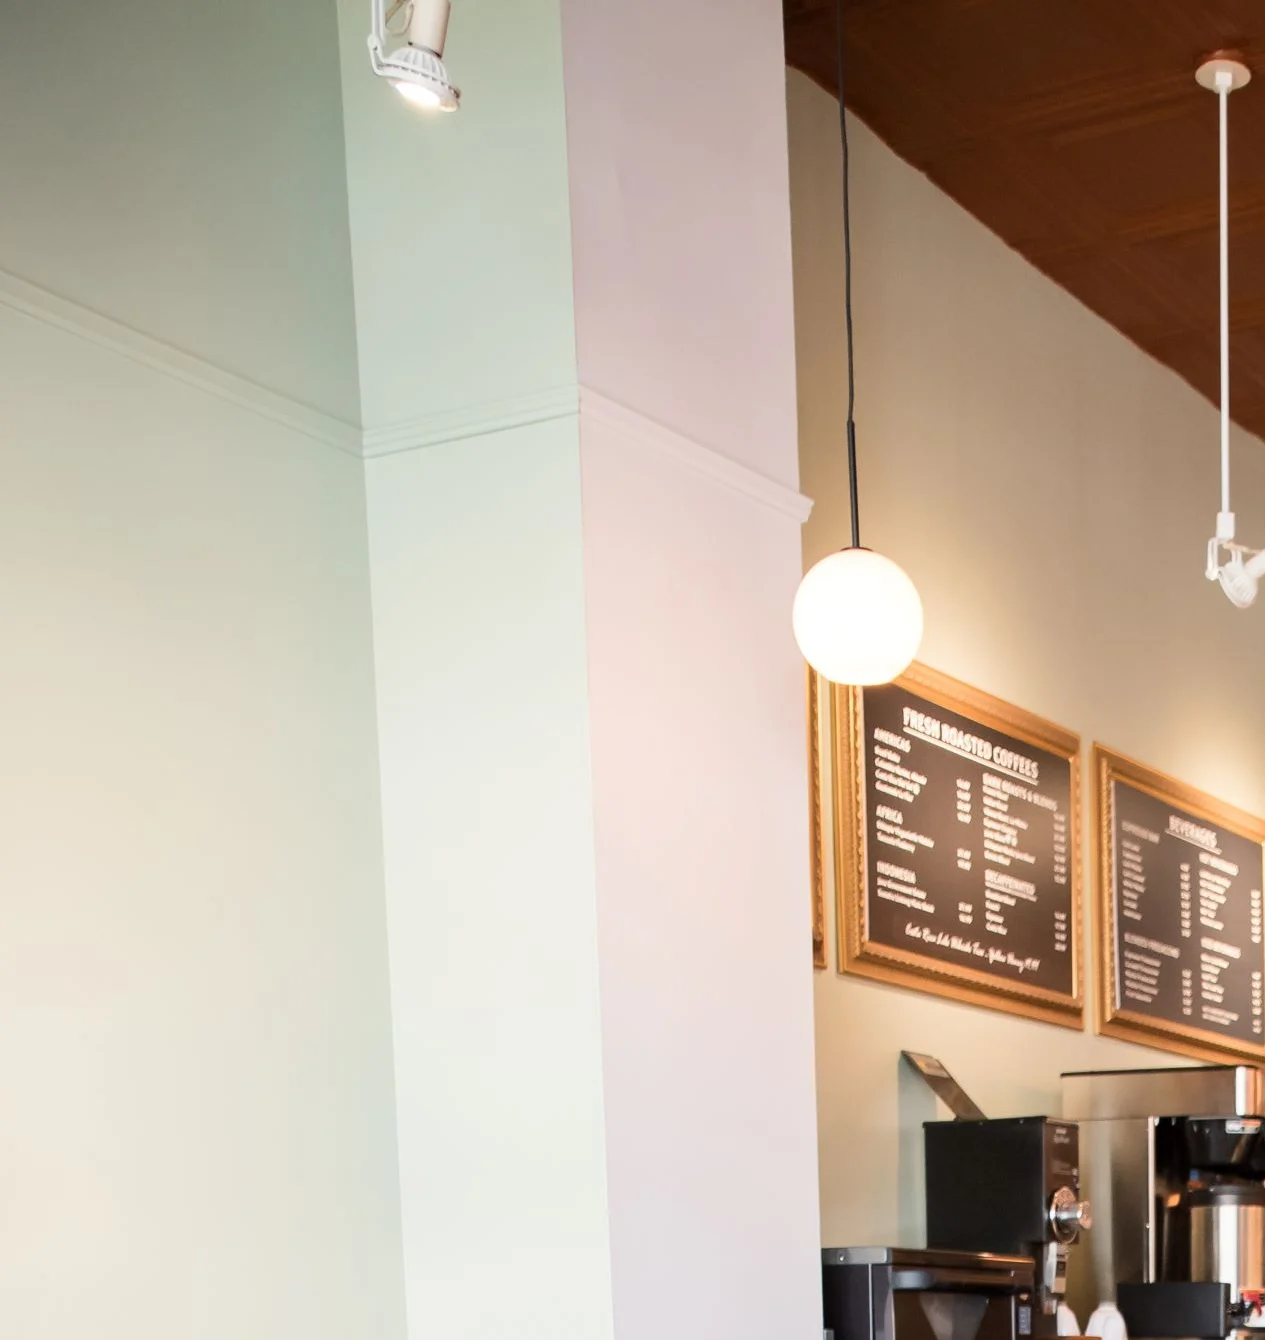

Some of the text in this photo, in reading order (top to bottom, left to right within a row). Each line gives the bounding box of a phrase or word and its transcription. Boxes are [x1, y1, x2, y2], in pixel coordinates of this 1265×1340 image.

[903, 706, 1039, 779] FRESH ROASTED COFFEES
